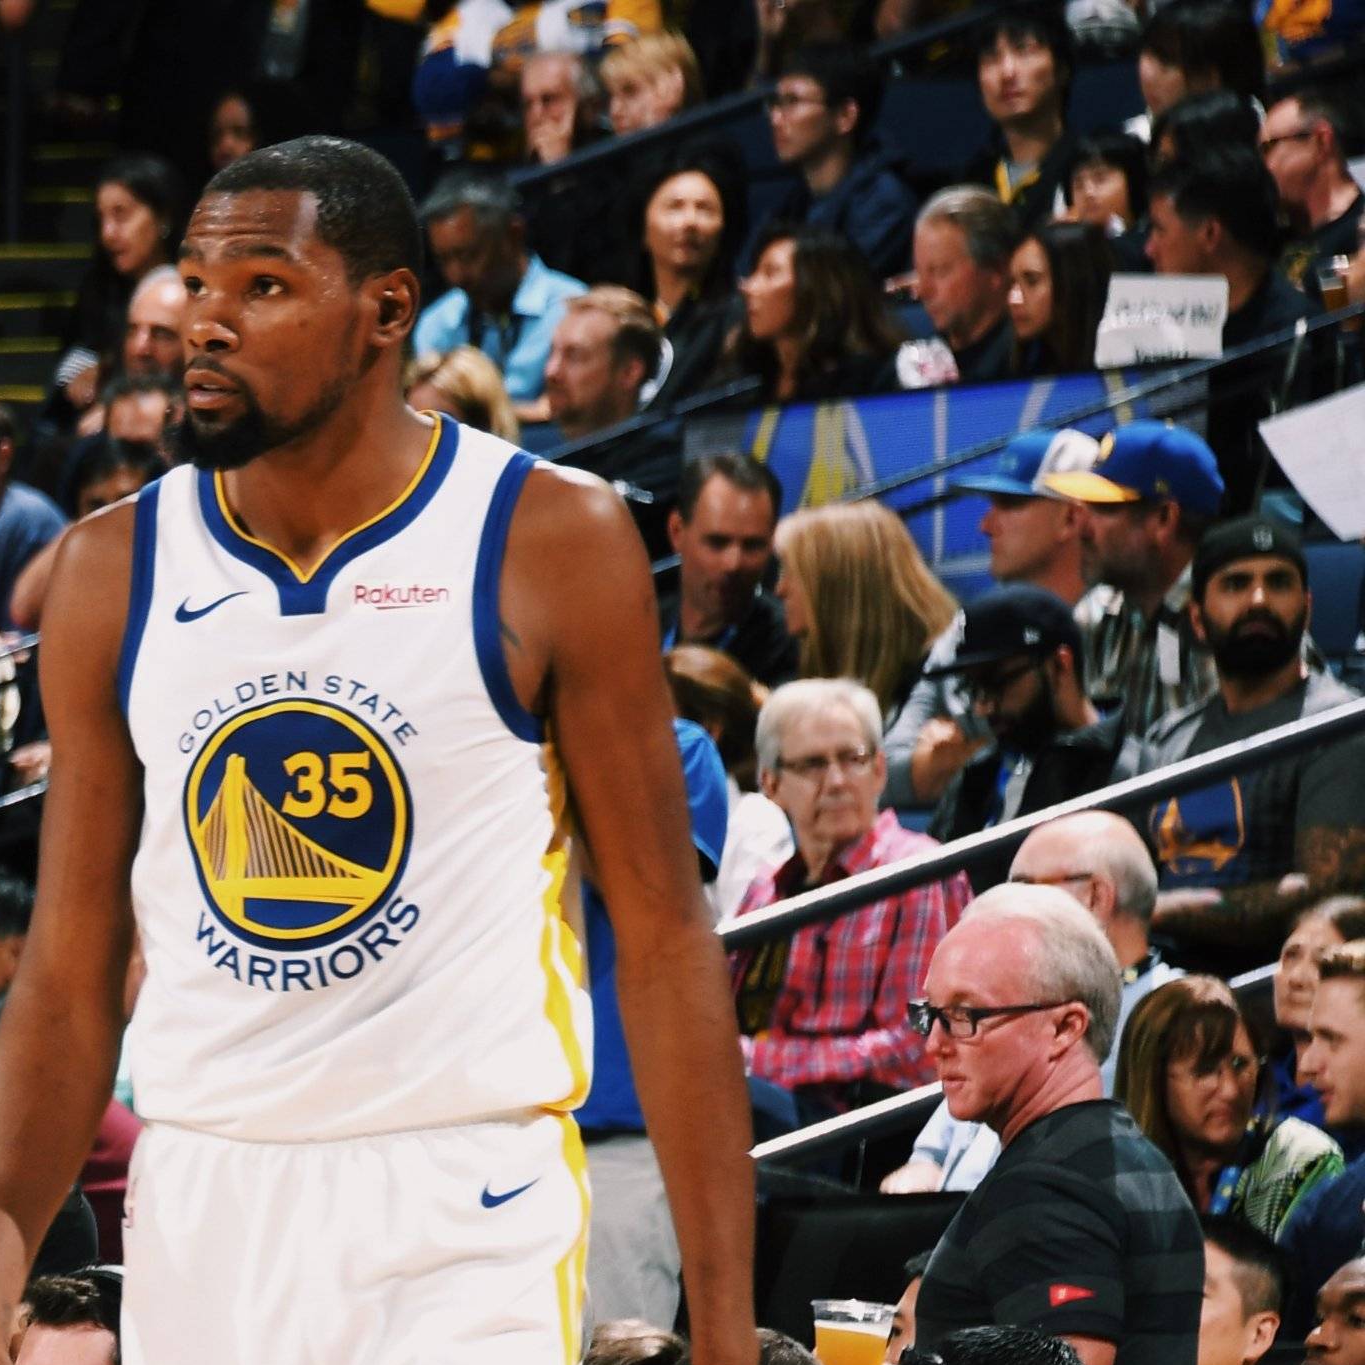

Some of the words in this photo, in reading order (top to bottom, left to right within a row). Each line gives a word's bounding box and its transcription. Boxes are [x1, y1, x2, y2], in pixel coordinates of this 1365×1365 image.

[354, 583, 450, 607] Rakuten
[178, 670, 308, 755] GOLDEN
[322, 674, 419, 747] STATE
[281, 749, 374, 819] 35
[195, 895, 420, 992] WARRIORS
